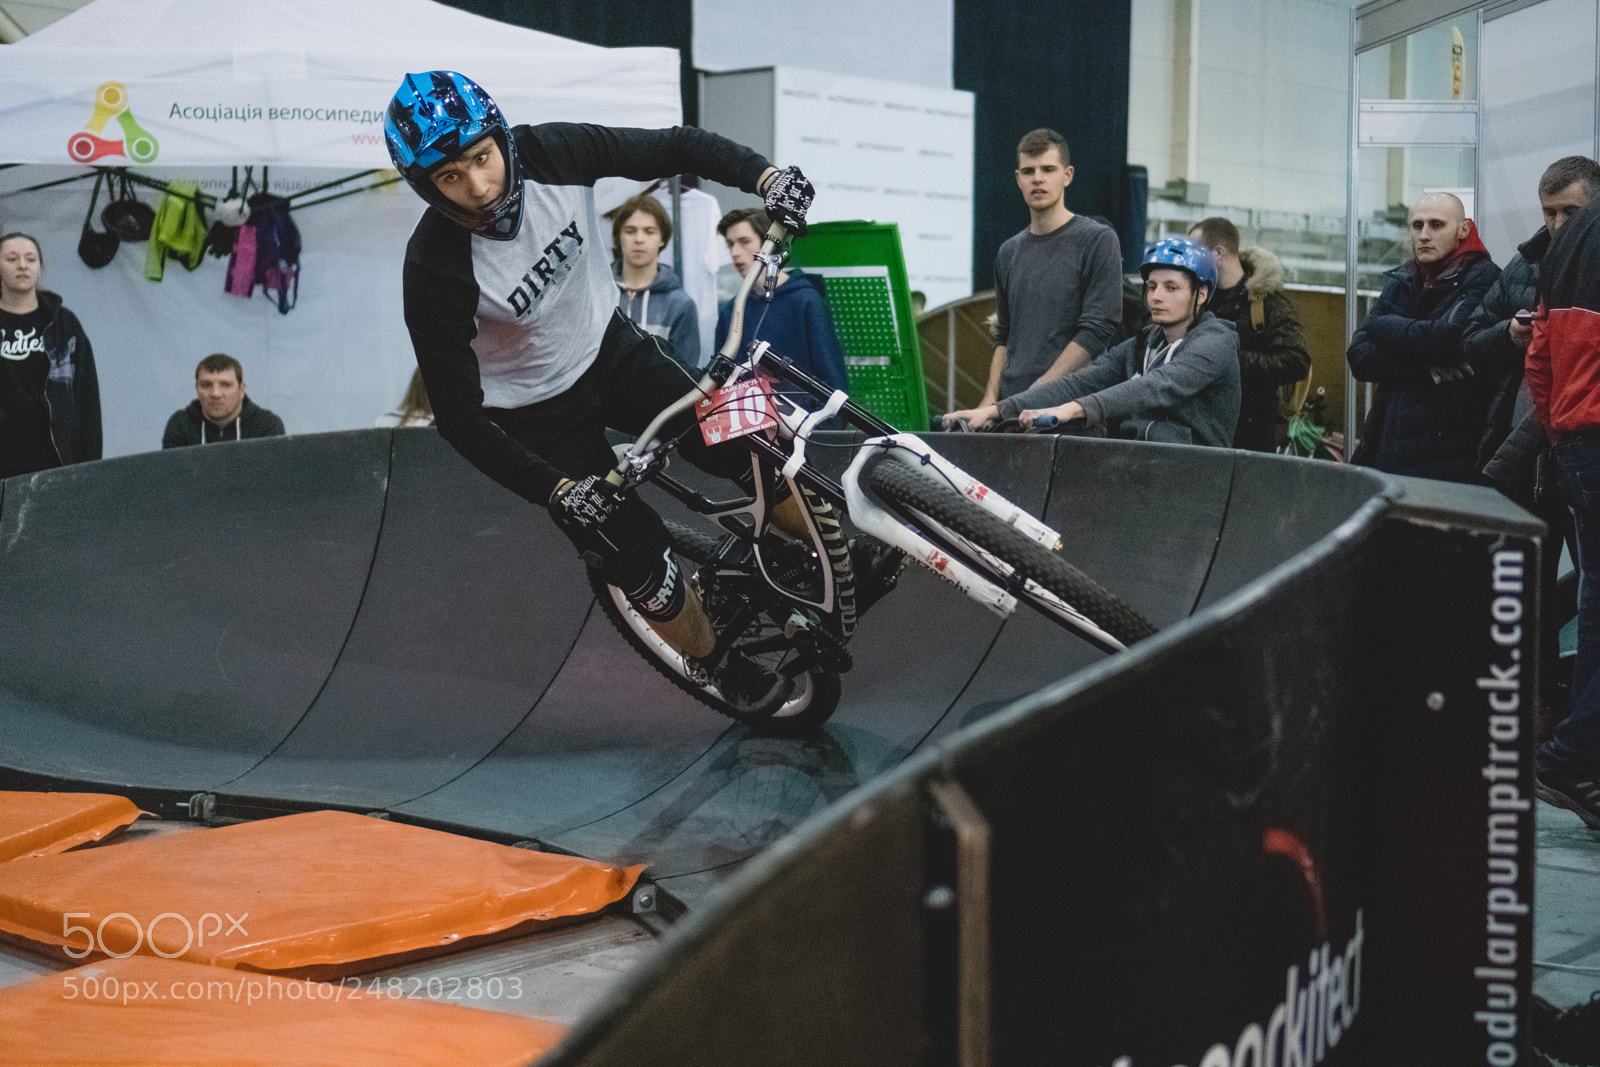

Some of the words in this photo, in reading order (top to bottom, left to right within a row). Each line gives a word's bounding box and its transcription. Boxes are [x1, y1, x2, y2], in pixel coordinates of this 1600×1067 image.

[169, 103, 263, 122] Асоціація
[352, 133, 387, 145] ww
[507, 220, 584, 318] DIRTY
[725, 386, 766, 433] 10
